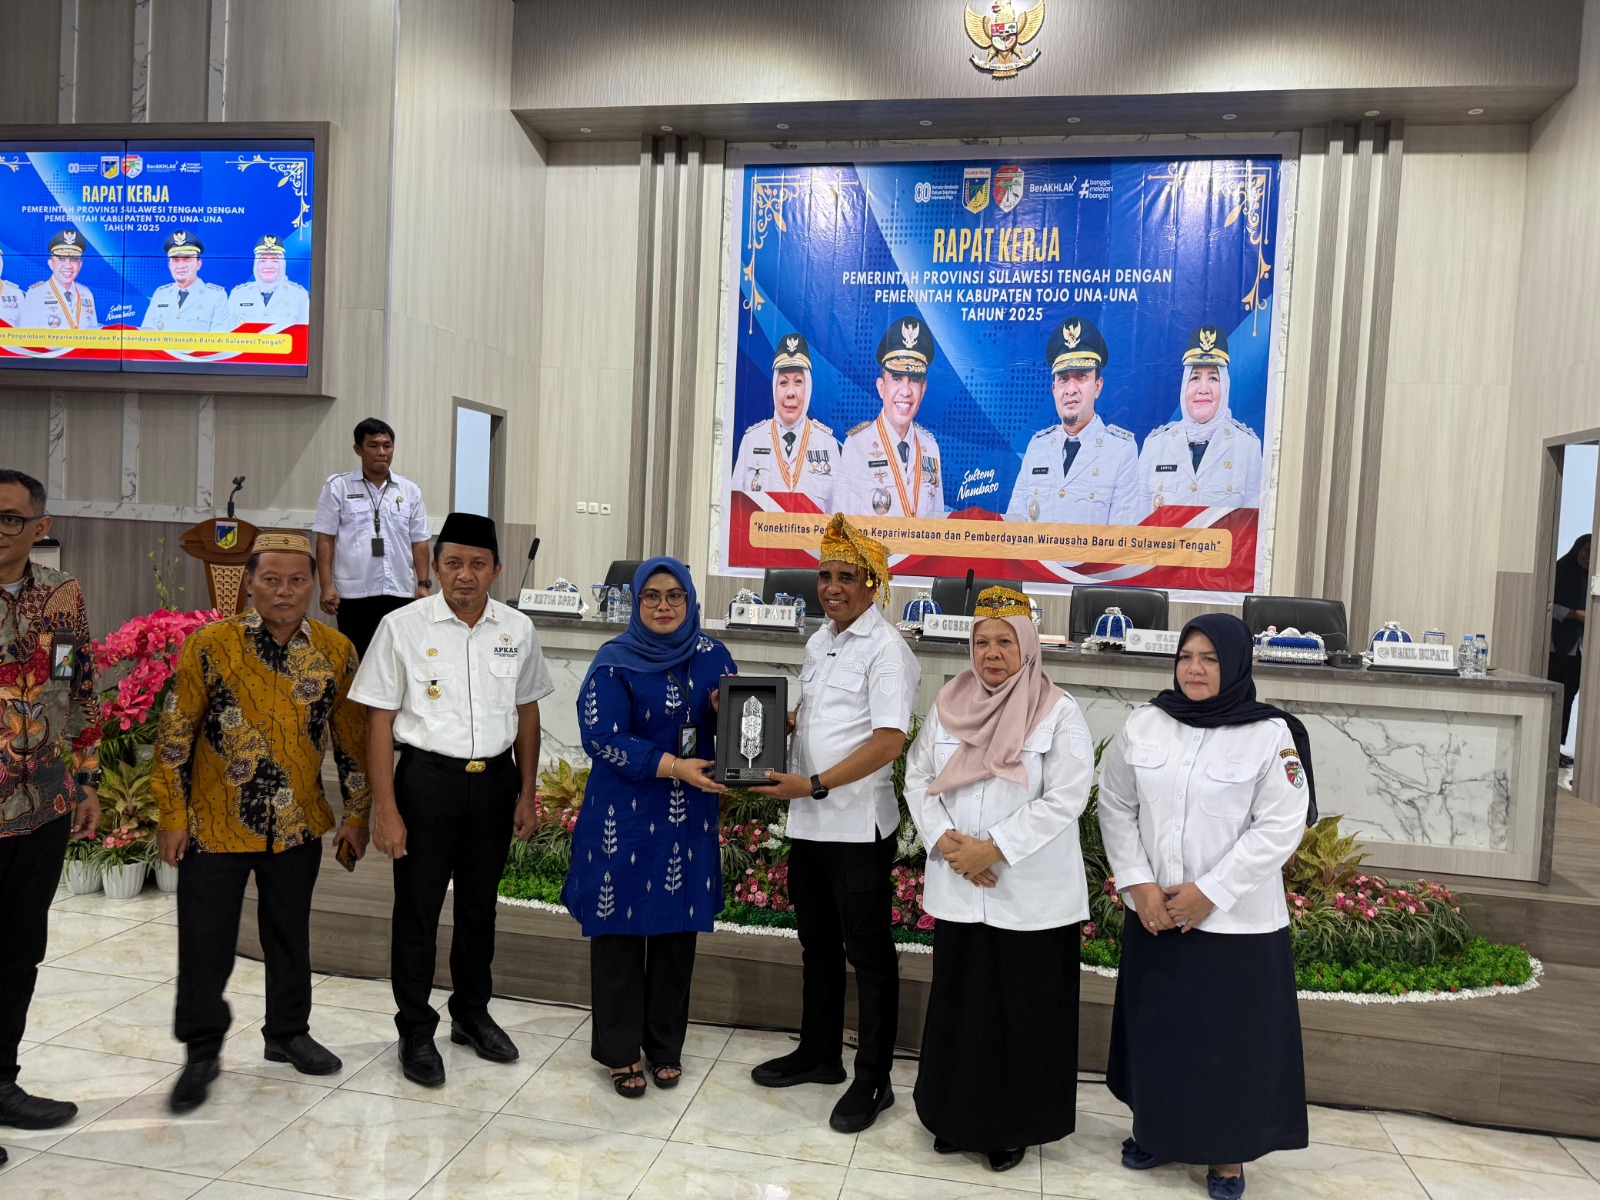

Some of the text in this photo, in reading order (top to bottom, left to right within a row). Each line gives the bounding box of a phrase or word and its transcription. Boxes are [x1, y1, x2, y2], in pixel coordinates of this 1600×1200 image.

[82, 185, 169, 203] RAPAT KERJA
[1029, 182, 1074, 192] BerAKHLAK
[168, 206, 204, 214] TENGAH
[206, 206, 245, 214] DENGAN
[44, 214, 97, 222] PEMERINTAH
[932, 226, 1060, 263] RAPAT KERJA
[842, 268, 1172, 285] PEMERINTAH PROVINSI SULAWESI TENGAH DENGAN
[875, 288, 1138, 303] PEMERINTAH KABUPATEN TOJO UNA-UNA
[961, 308, 1043, 321] TAHUN 2025
[962, 468, 995, 485] Sulteng
[956, 482, 999, 502] Nambaso
[754, 522, 810, 534] "Konektifitas
[871, 527, 941, 540] Kepariwisataan
[944, 530, 961, 540] dan
[964, 531, 1033, 545] Pemberdayaan
[1038, 534, 1088, 546] Wirausaha
[1092, 536, 1114, 547] Baru
[1118, 537, 1127, 547] di
[1131, 538, 1176, 549] Sulawesi
[1179, 539, 1221, 552] Tengah"
[534, 594, 577, 607] KETUA DPRD
[748, 607, 792, 620] BUPATI
[942, 620, 970, 632] GUBER
[1155, 634, 1179, 642] WAKI
[1390, 647, 1449, 662] WAKIL BUPATI
